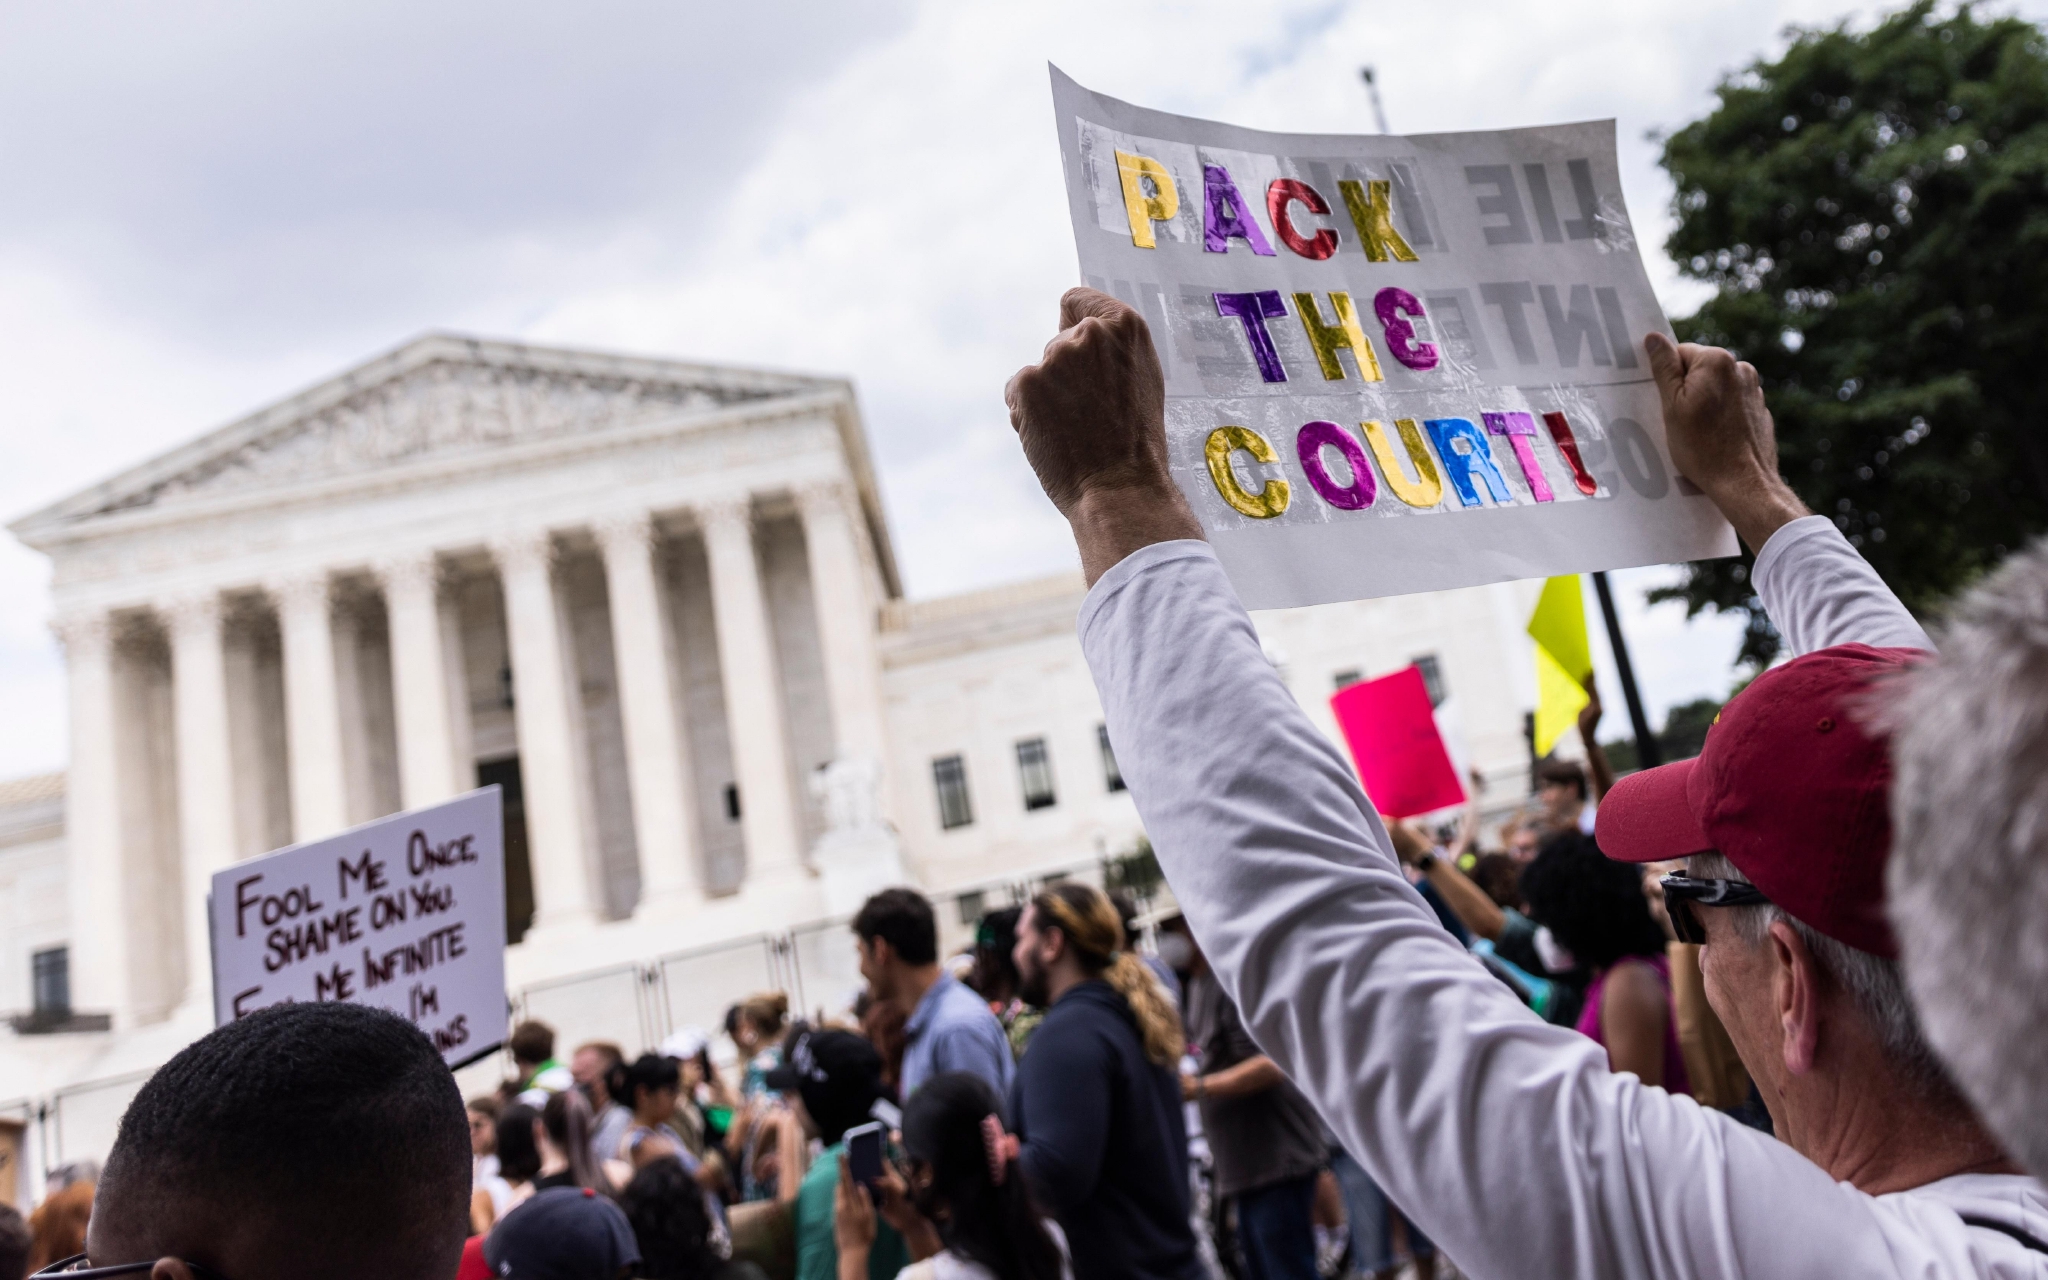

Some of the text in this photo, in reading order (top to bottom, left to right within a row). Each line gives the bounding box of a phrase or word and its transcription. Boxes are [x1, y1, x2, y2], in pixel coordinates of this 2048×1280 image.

[1114, 149, 1420, 263] PACK
[1212, 286, 1441, 384] THE
[1204, 410, 1598, 520] COURT!
[236, 872, 324, 938] FOOL
[338, 848, 389, 900] ME
[264, 906, 365, 974] SHAME
[370, 891, 406, 932] ON
[316, 921, 468, 1001] ME INFINITE
